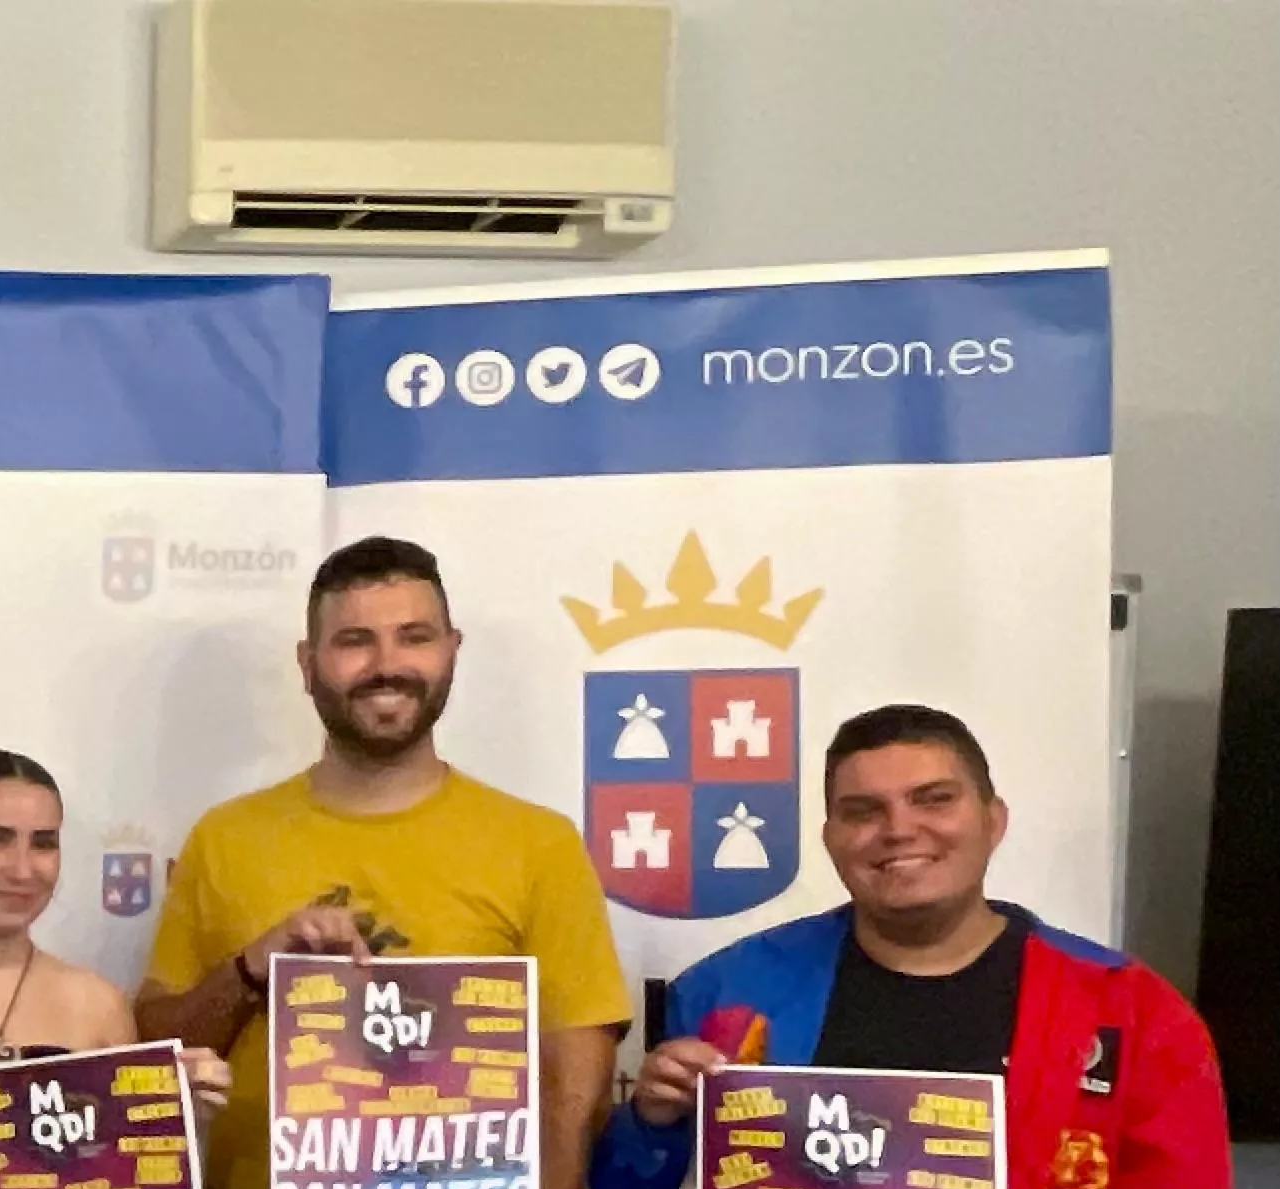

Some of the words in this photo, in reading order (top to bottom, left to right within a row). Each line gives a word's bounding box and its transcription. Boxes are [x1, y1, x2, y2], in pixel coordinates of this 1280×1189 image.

[701, 331, 1014, 387] monzon.es
[168, 540, 296, 571] Monzón
[365, 981, 400, 1013] M
[363, 1010, 432, 1052] QD!
[30, 1080, 63, 1114] M
[808, 1093, 849, 1131] M
[32, 1106, 95, 1152] QD!
[273, 1117, 361, 1172] SAN
[373, 1107, 529, 1172] MATEO
[805, 1127, 885, 1174] QD!
